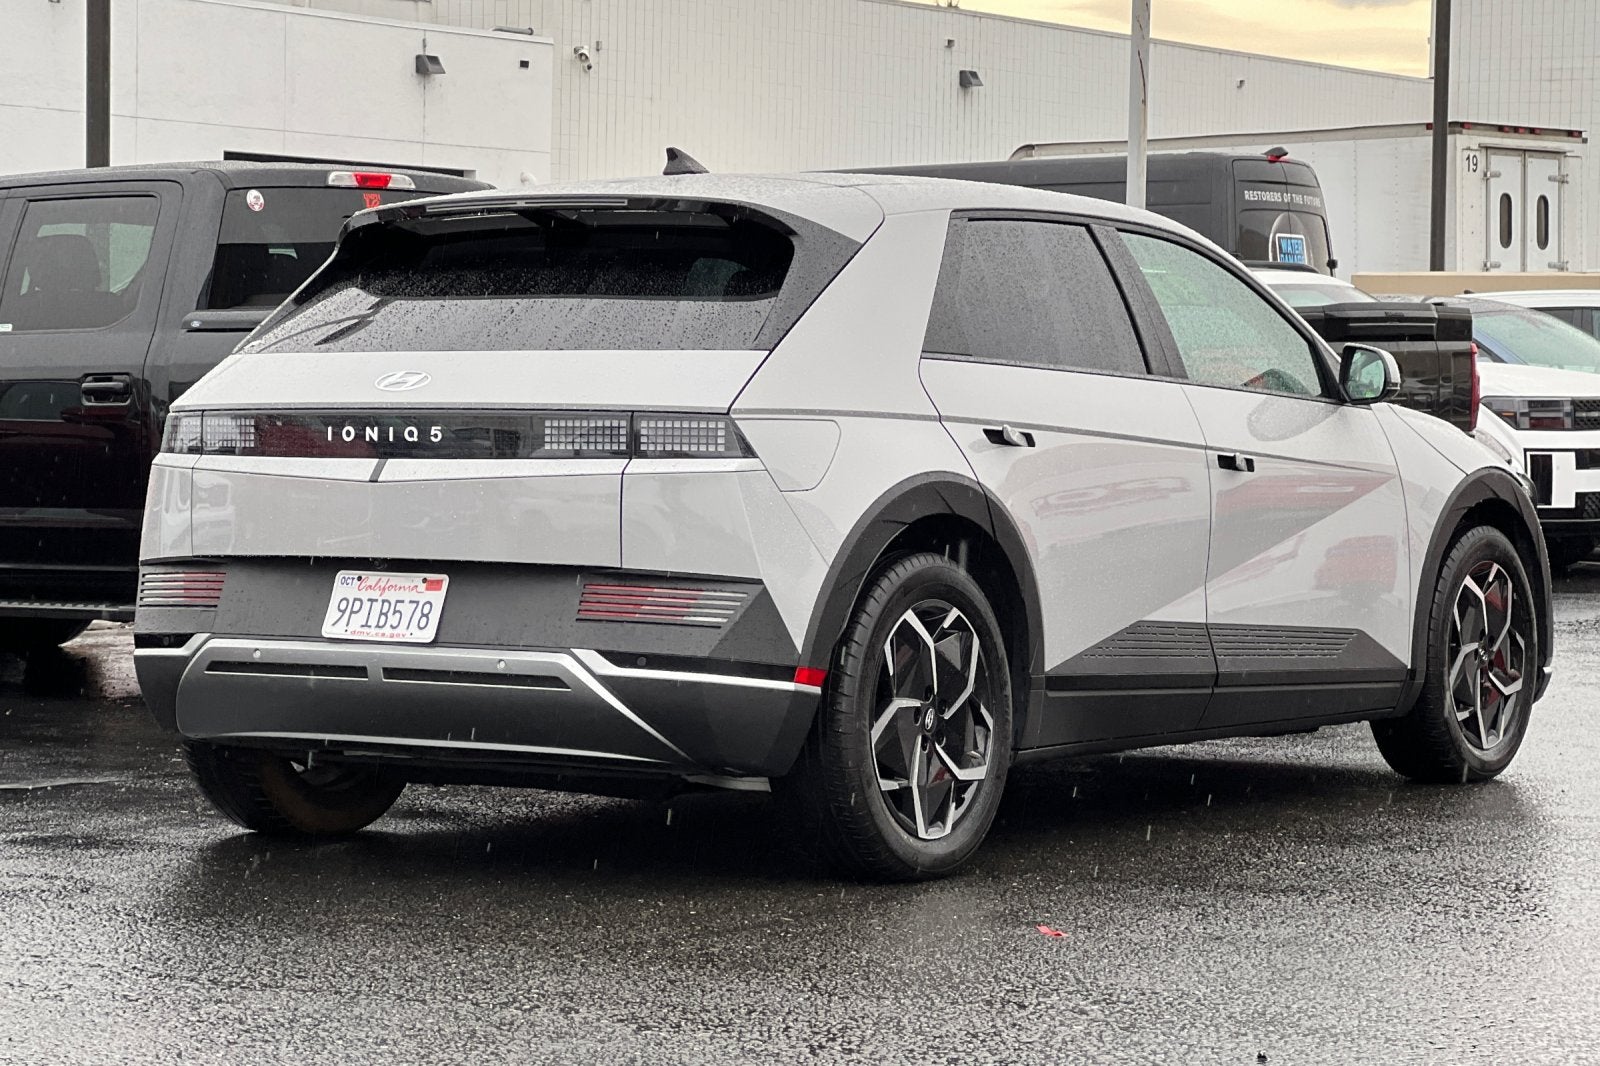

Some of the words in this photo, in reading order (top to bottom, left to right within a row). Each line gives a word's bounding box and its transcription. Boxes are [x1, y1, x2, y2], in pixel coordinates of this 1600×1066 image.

[1466, 154, 1478, 172] 19
[1244, 190, 1282, 202] RESTORERS
[1283, 193, 1292, 203] OF
[1292, 194, 1303, 205] THE
[1280, 238, 1303, 254] WATER
[327, 426, 418, 442] IONIQ
[430, 426, 442, 442] 5
[340, 576, 355, 586] OCT
[357, 576, 424, 597] California
[331, 597, 433, 630] 9PIB578
[350, 629, 407, 639] dmv.ca.gov
